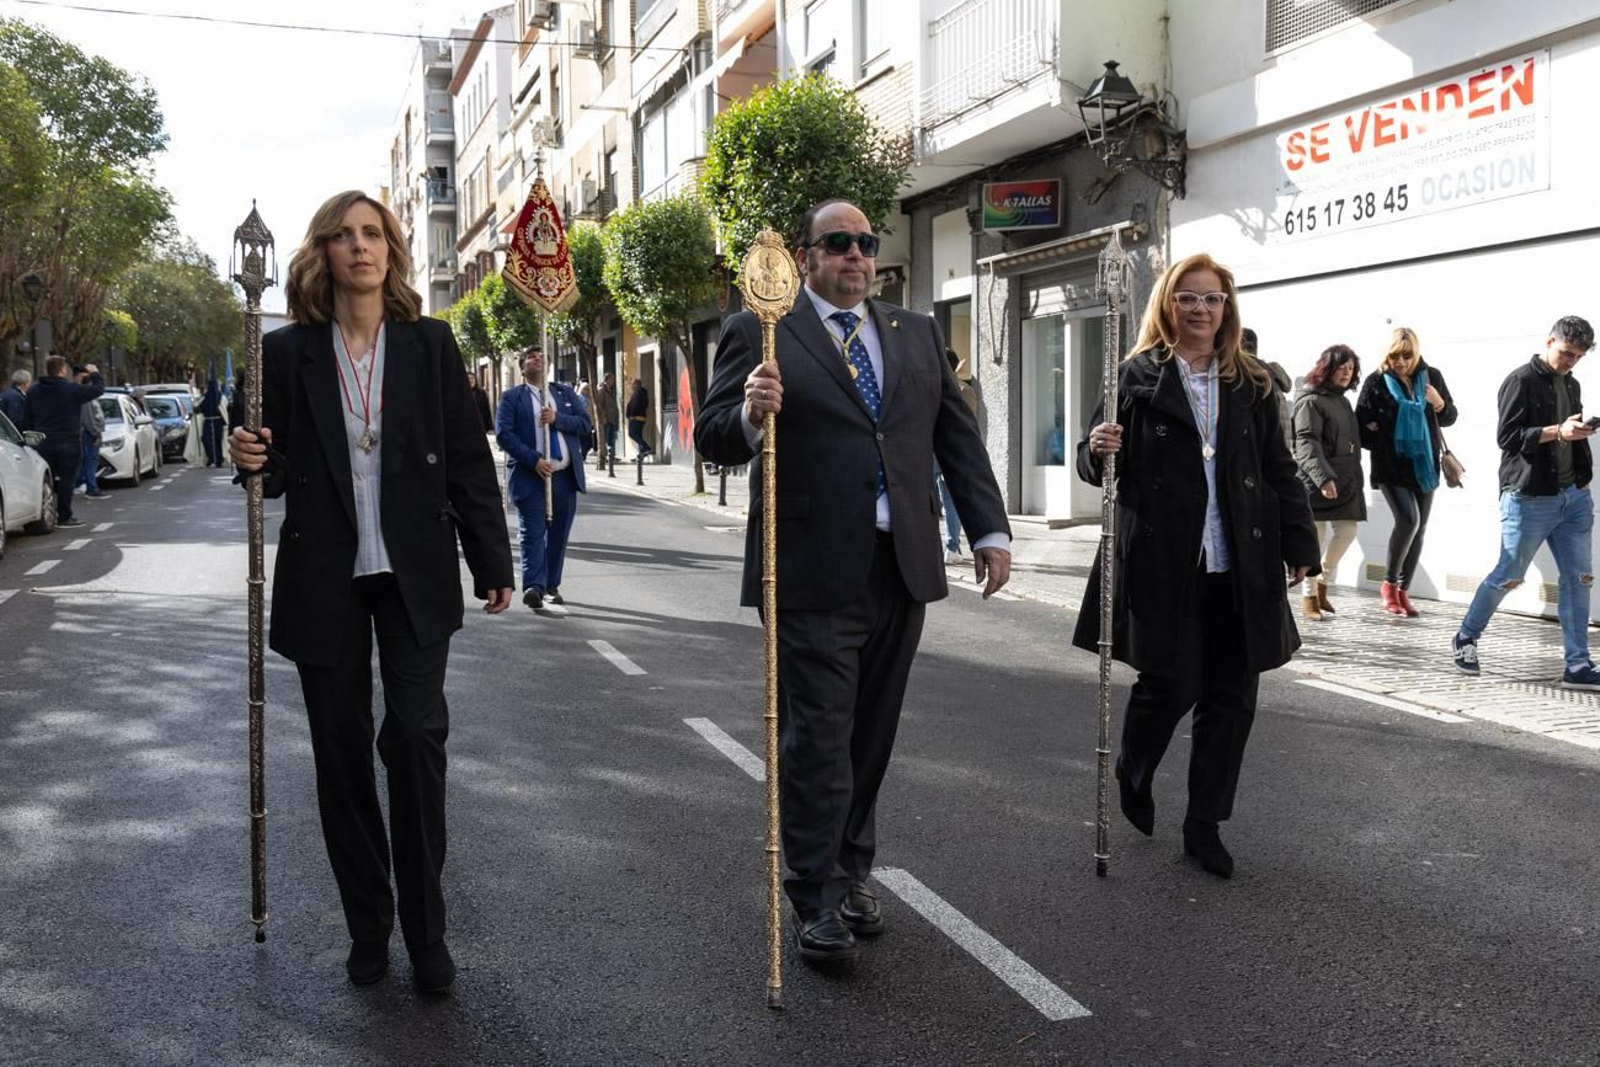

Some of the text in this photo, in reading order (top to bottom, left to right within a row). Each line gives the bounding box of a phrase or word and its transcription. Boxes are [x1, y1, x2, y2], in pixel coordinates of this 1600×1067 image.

[1286, 123, 1330, 171] SE
[1344, 57, 1534, 154] VENDEN
[1284, 207, 1316, 235] 615
[1324, 199, 1345, 227] 17
[1353, 192, 1376, 221] 38
[1383, 184, 1408, 213] 45
